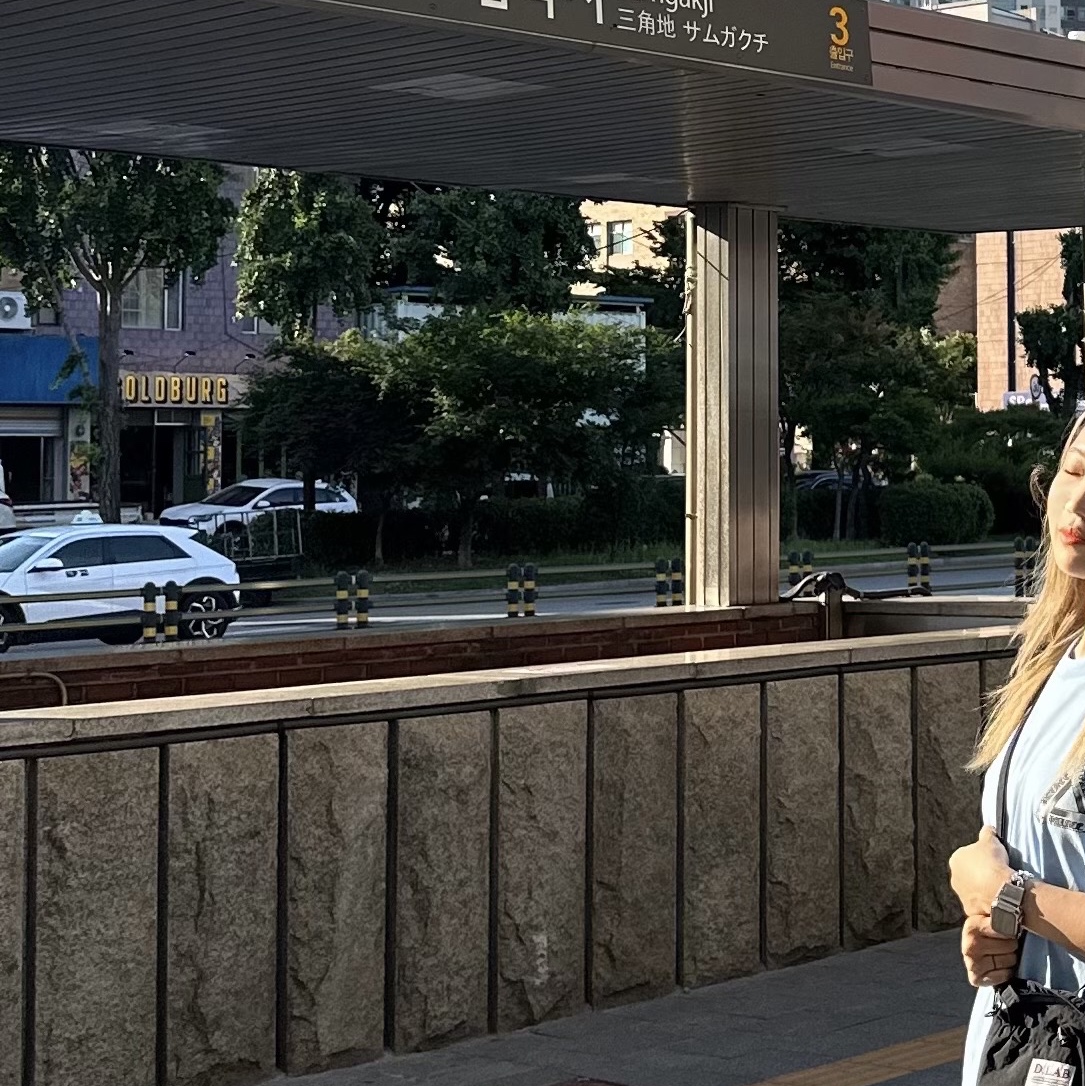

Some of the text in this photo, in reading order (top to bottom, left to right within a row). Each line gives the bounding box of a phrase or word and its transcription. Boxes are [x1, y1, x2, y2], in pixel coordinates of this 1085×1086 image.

[617, 8, 676, 39] 三角地
[683, 21, 769, 53] サムガクチ
[829, 6, 849, 46] 3
[121, 374, 228, 404] OLDBURG
